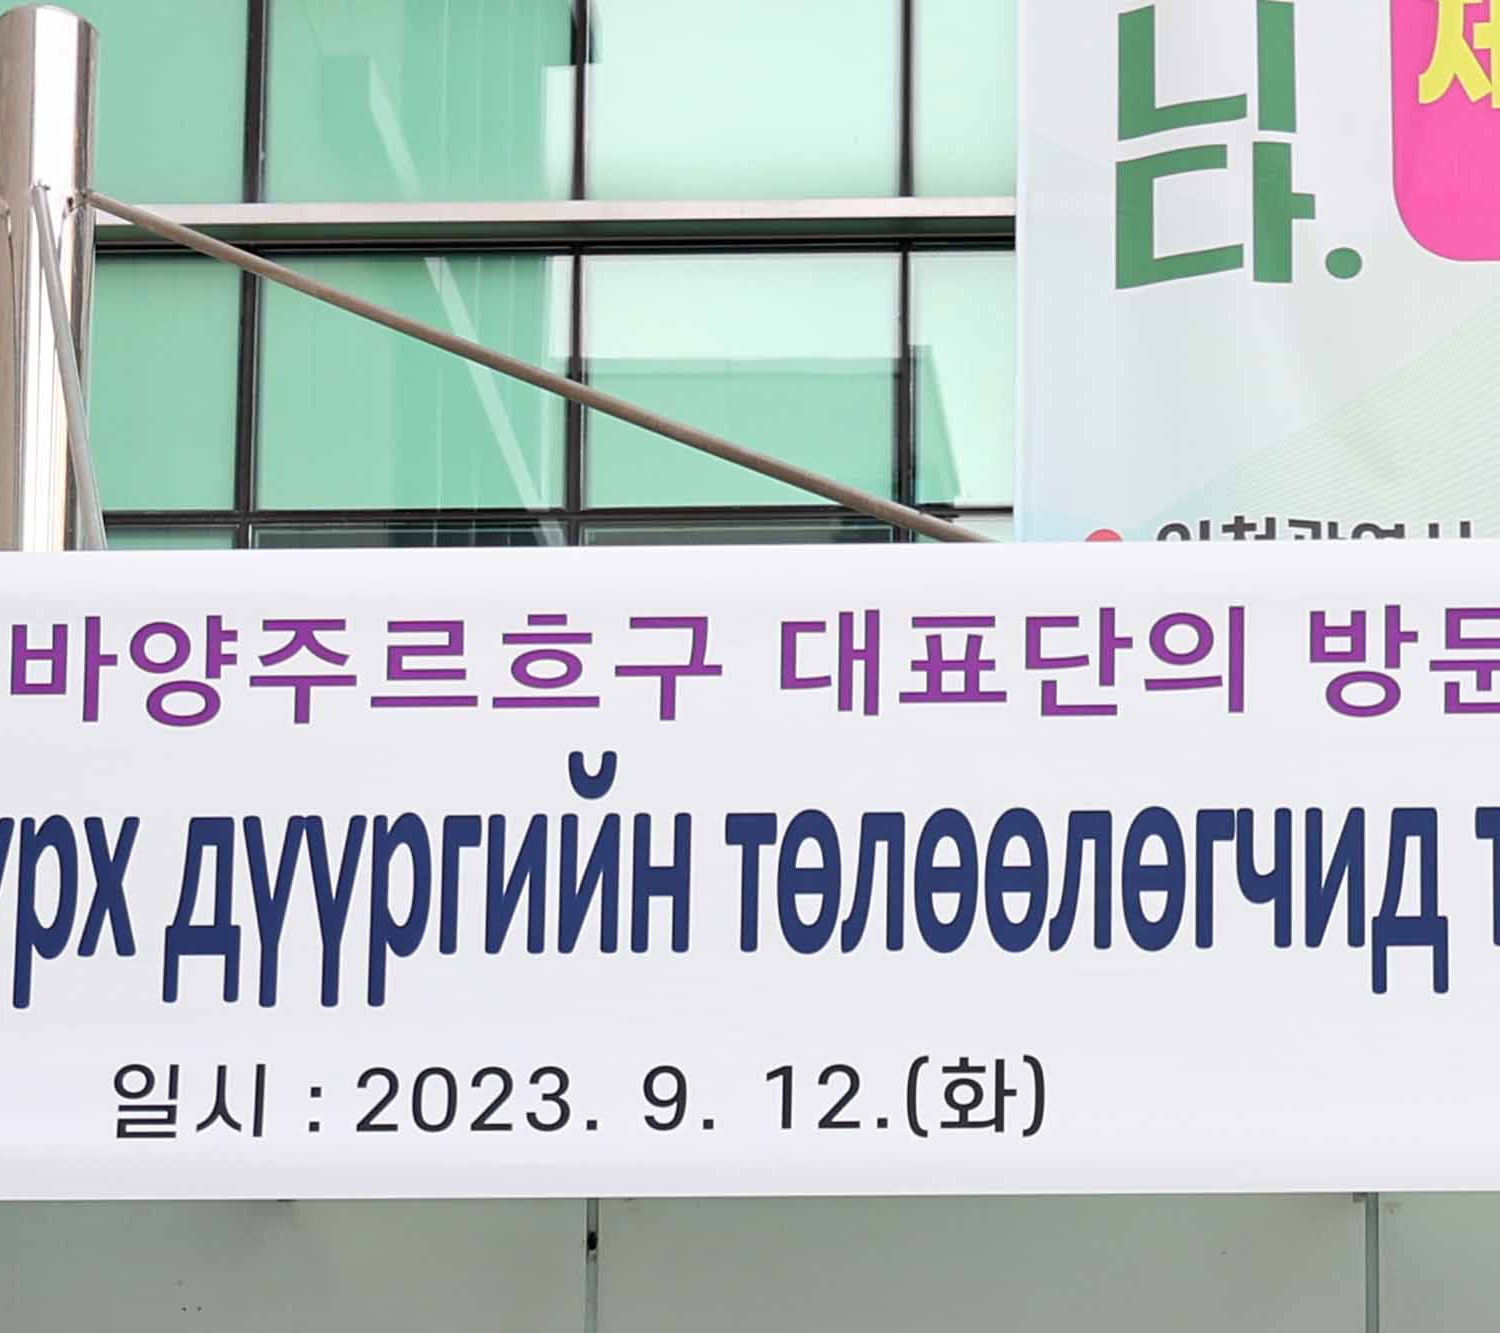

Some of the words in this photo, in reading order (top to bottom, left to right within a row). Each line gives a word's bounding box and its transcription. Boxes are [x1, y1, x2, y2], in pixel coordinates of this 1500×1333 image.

[12, 615, 721, 726] 바양주르흐구
[783, 608, 1243, 718] 대표단의
[162, 751, 692, 1007] дүүргийн
[725, 807, 1449, 994] төлөөлөгчид
[114, 1063, 266, 1139] 일시
[309, 1087, 321, 1132] :
[357, 1066, 598, 1132] 2023.
[644, 1065, 714, 1131] 9.
[767, 1055, 1045, 1138] 12.(화)
